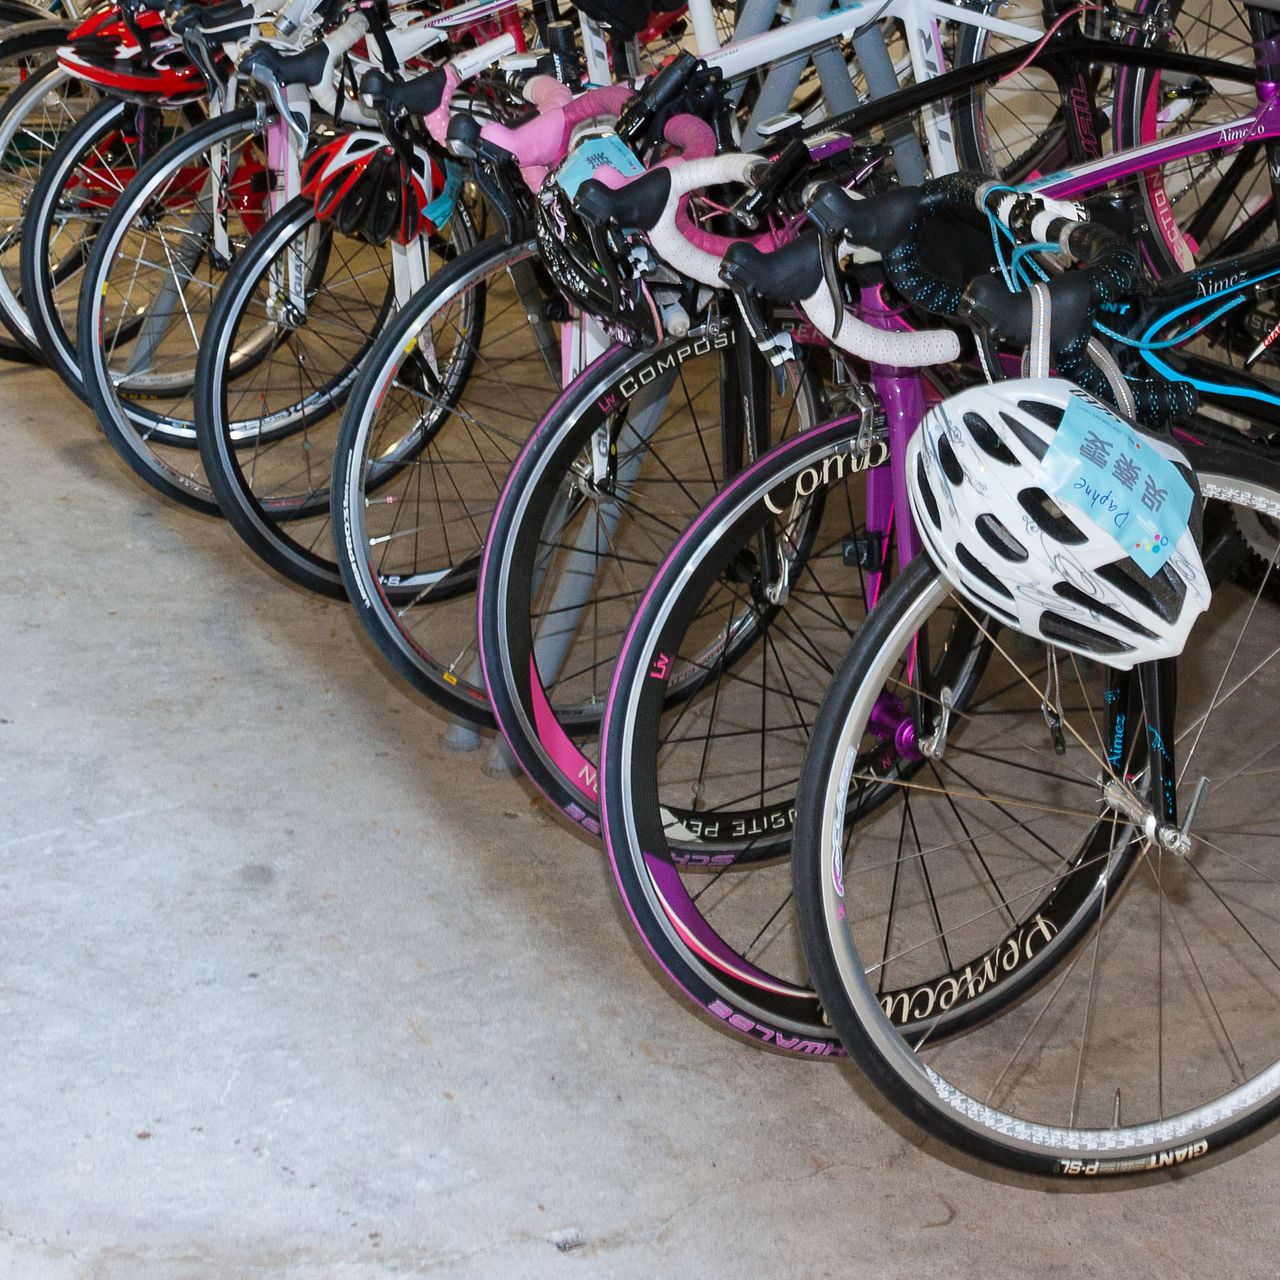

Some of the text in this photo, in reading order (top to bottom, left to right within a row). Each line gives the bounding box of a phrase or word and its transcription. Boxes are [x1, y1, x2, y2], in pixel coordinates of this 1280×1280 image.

[1073, 477, 1130, 528] Daphne
[650, 652, 669, 680] Liv
[1108, 712, 1126, 769] Aimez
[1146, 1138, 1209, 1169] GIANT
